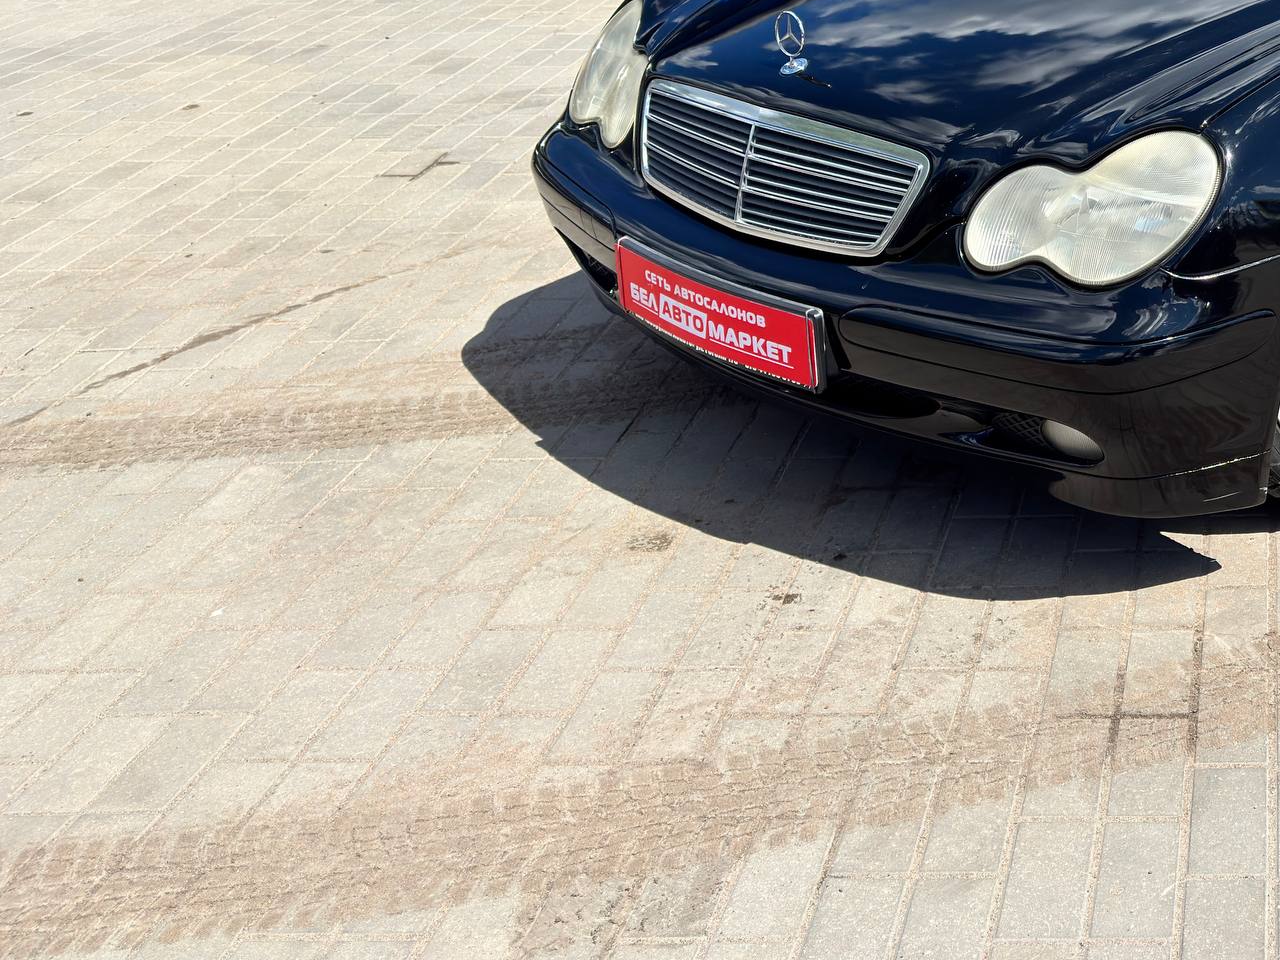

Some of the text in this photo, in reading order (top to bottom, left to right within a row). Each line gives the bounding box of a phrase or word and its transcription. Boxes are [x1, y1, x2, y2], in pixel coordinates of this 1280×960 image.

[630, 282, 659, 312] БЕЛ
[661, 299, 705, 334] АВТО
[707, 319, 793, 364] МАРКЕТ
[644, 269, 767, 328] СЕТЬ АВТОСАЛОНОВ
